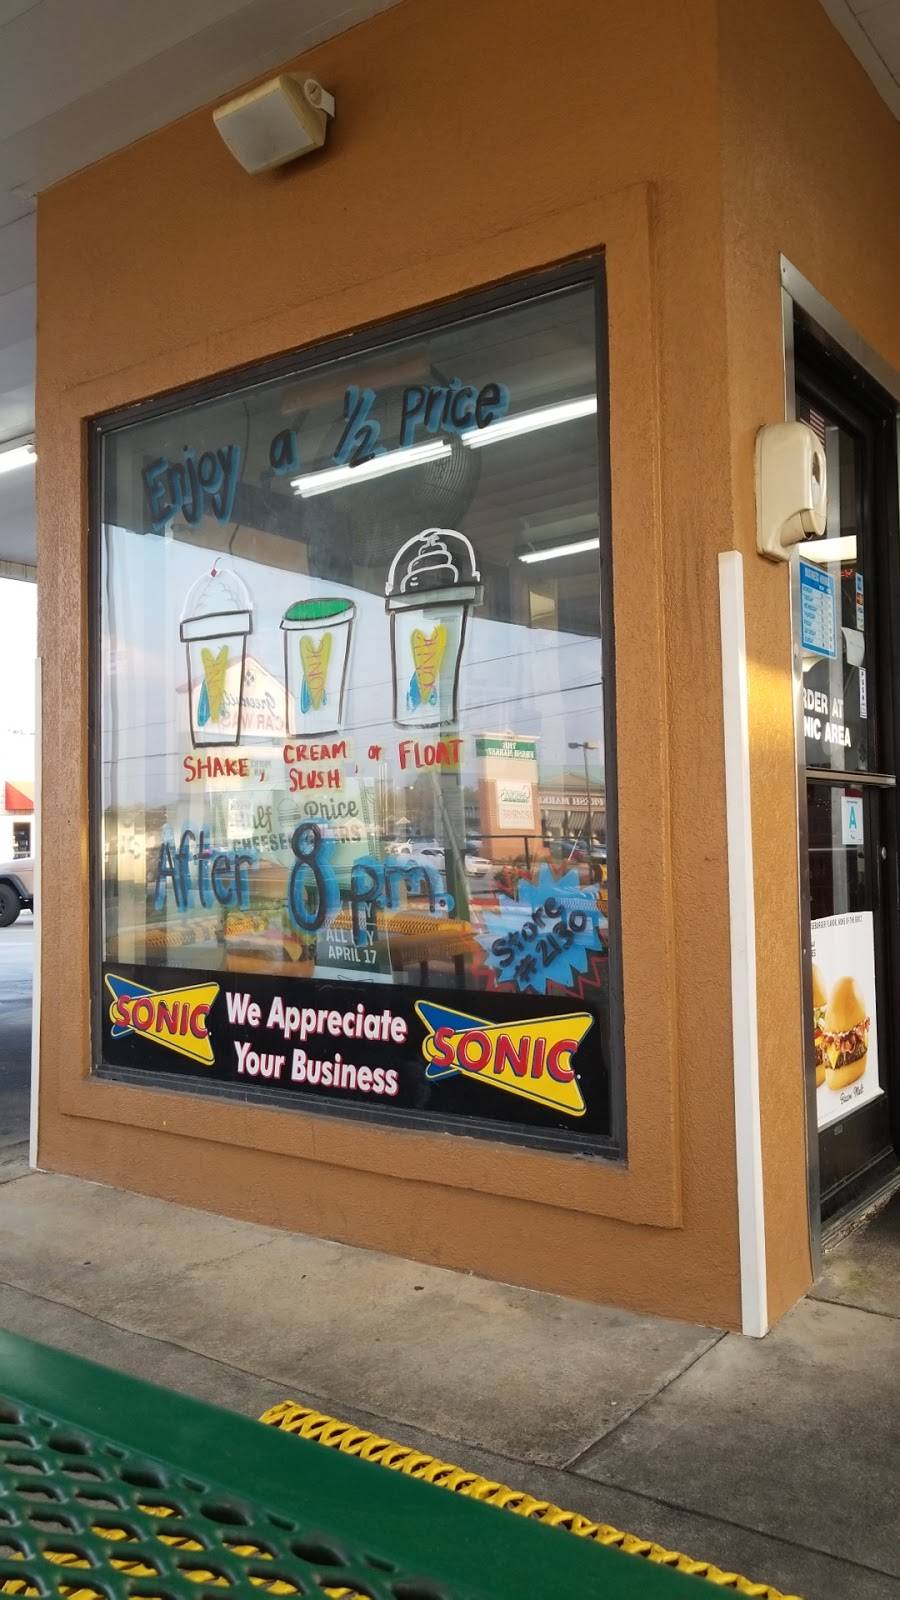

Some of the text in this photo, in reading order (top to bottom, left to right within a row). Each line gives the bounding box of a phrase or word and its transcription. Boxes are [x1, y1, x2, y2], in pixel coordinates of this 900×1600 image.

[142, 444, 241, 528] Enjoy
[268, 428, 296, 476] a
[803, 688, 845, 718] RDER AT
[283, 741, 347, 764] CREAM
[399, 740, 463, 769] FLOAT
[803, 715, 852, 748] NIC AREA
[848, 806, 857, 829] A
[151, 825, 258, 913] After
[288, 820, 341, 932] 8
[326, 928, 348, 943] ALL
[328, 945, 376, 964] APRIL 17
[492, 897, 566, 968] Store
[113, 994, 211, 1040] SONIC
[226, 991, 408, 1046] We Appreciate
[234, 1040, 400, 1097] Your Business
[430, 1026, 579, 1084] SONIC
